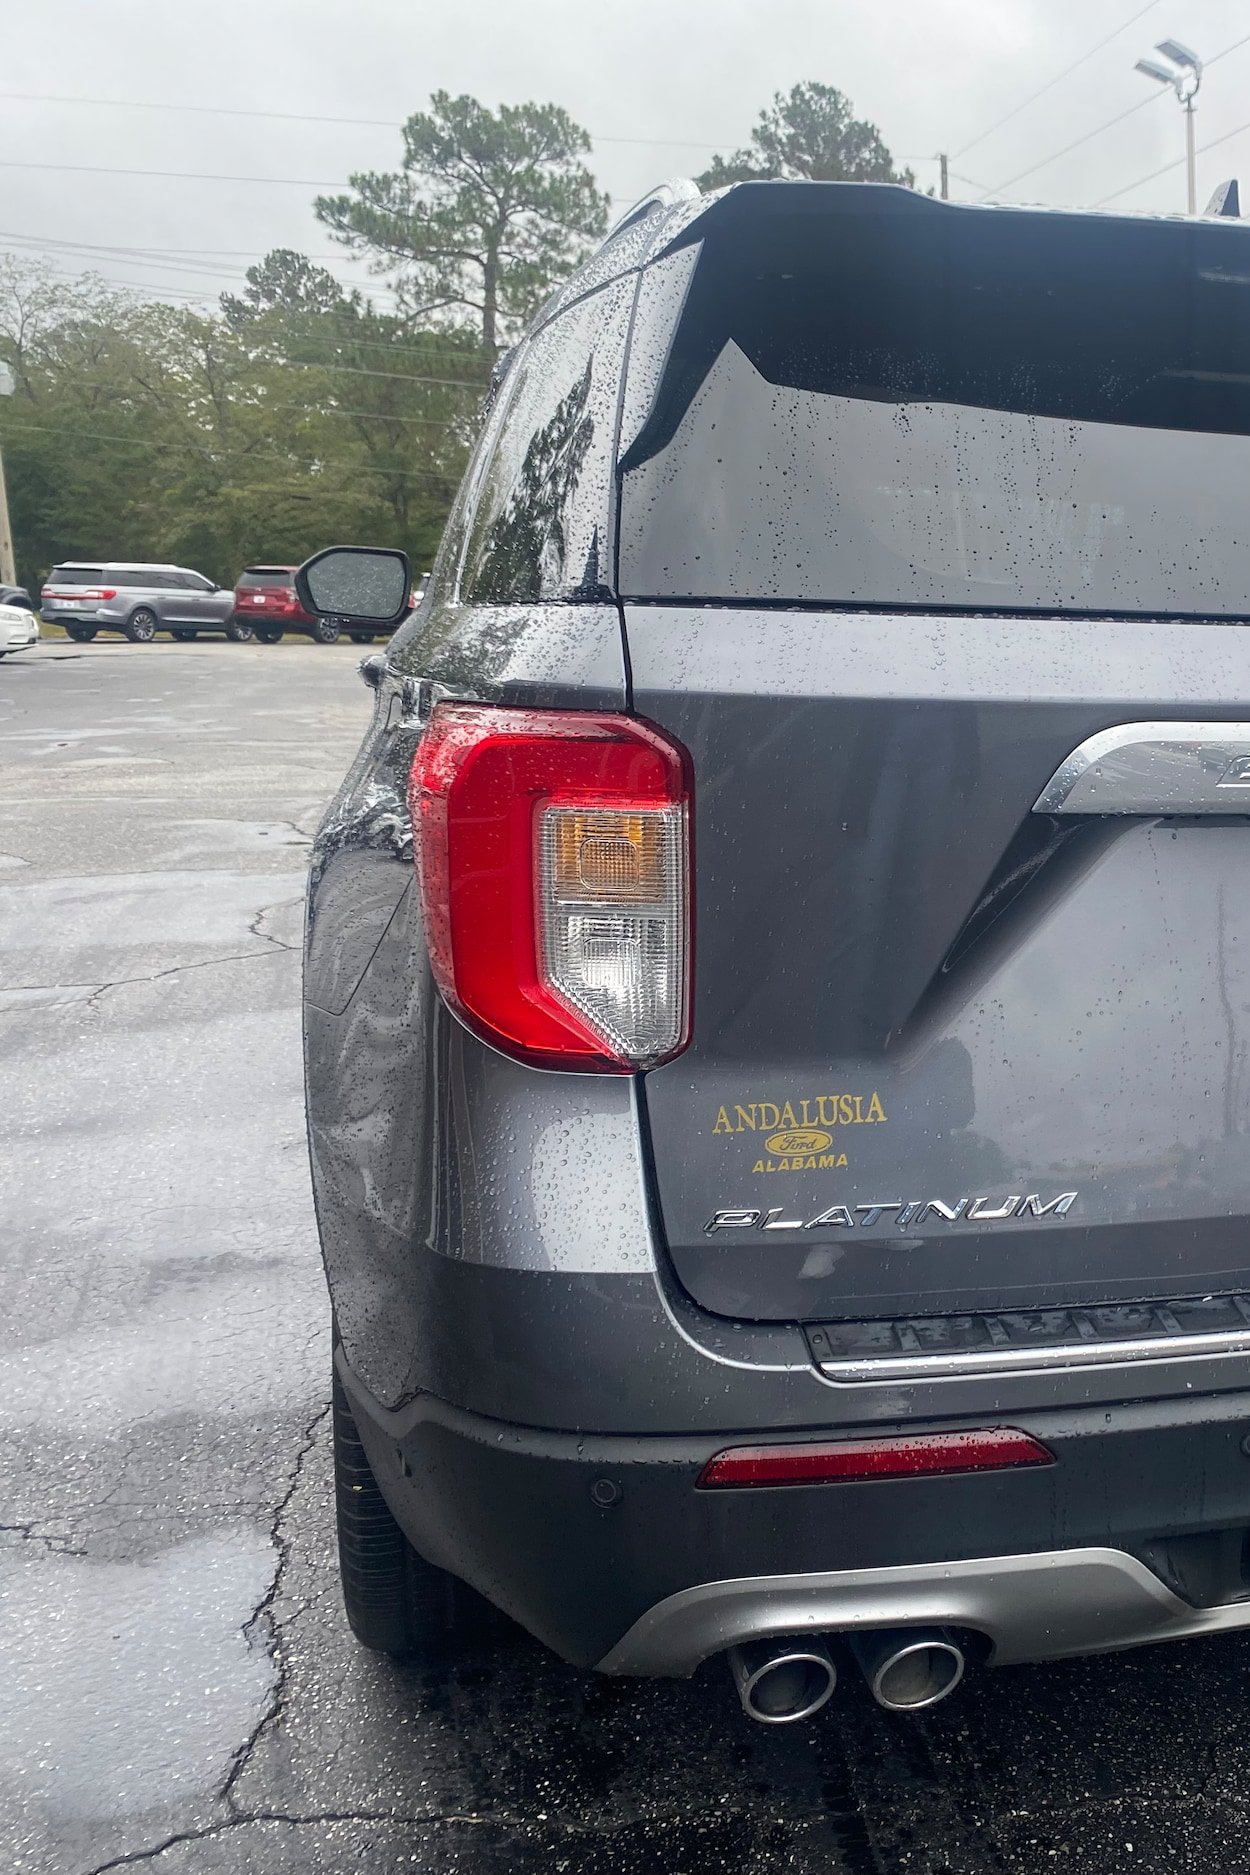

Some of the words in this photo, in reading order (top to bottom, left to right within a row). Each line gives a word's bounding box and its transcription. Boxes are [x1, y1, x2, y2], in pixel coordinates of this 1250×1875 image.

[712, 1091, 888, 1134] ANDALUSIA
[752, 1153, 849, 1174] ALABAMA
[703, 1192, 1079, 1233] PLATINUM
